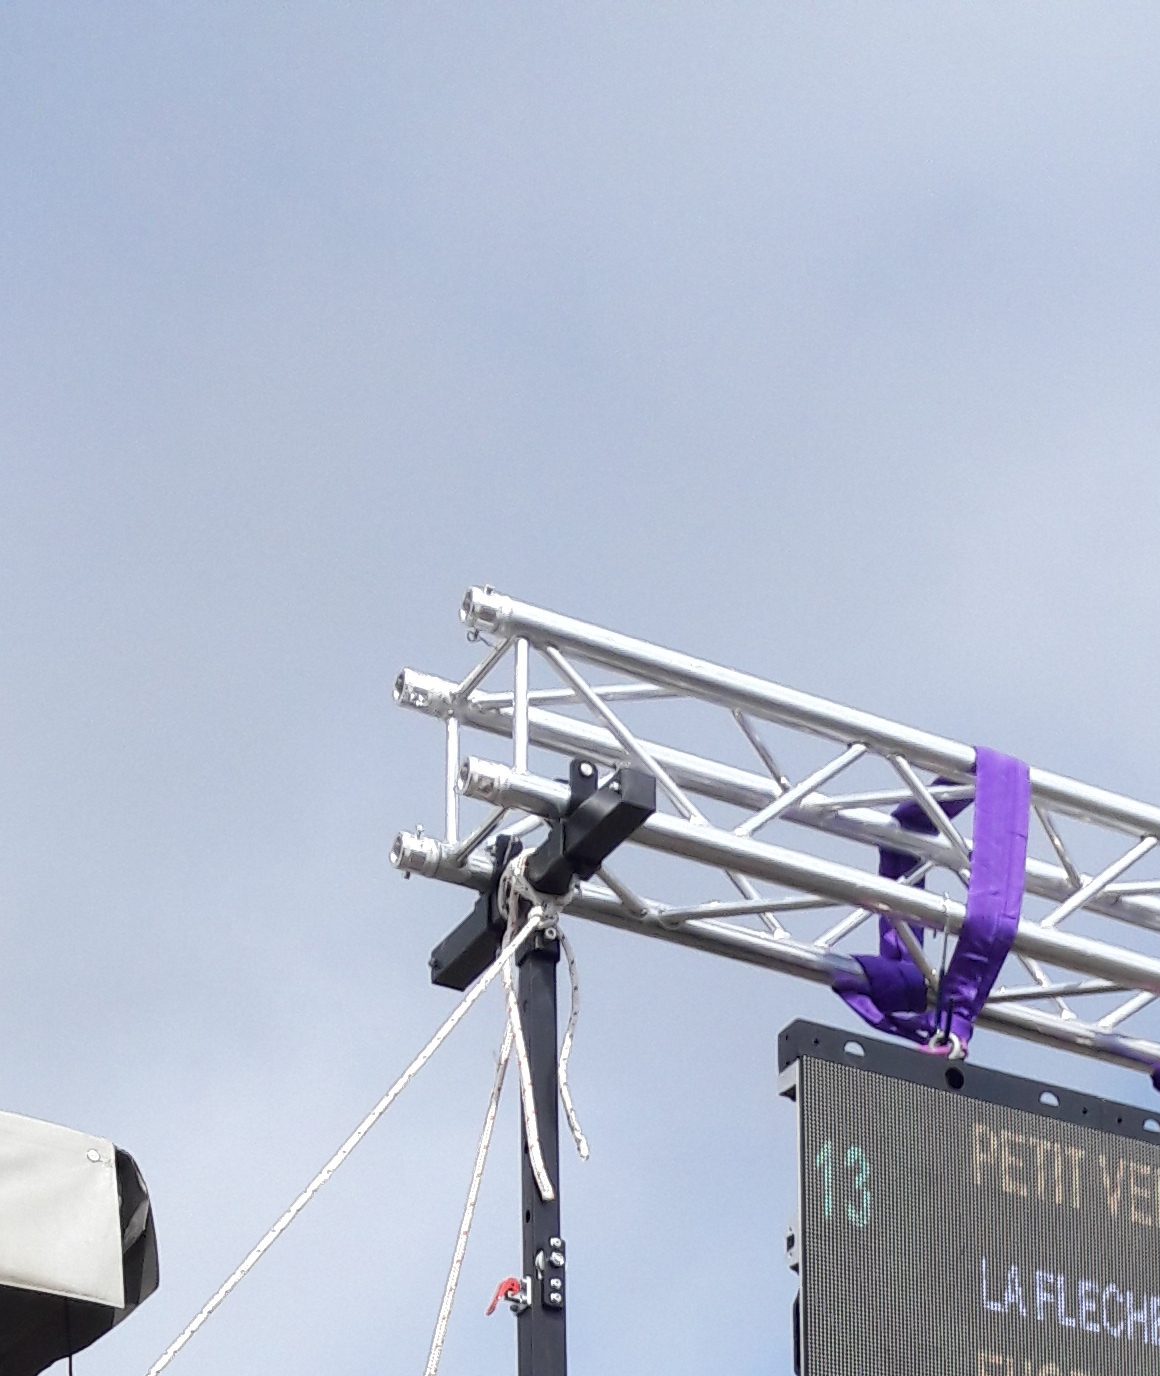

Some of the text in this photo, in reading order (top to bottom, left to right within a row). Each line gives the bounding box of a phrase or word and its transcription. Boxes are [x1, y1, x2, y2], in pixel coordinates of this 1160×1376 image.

[816, 1141, 871, 1228] 13
[974, 1123, 1083, 1211] PETIT
[981, 1256, 1025, 1318] LA
